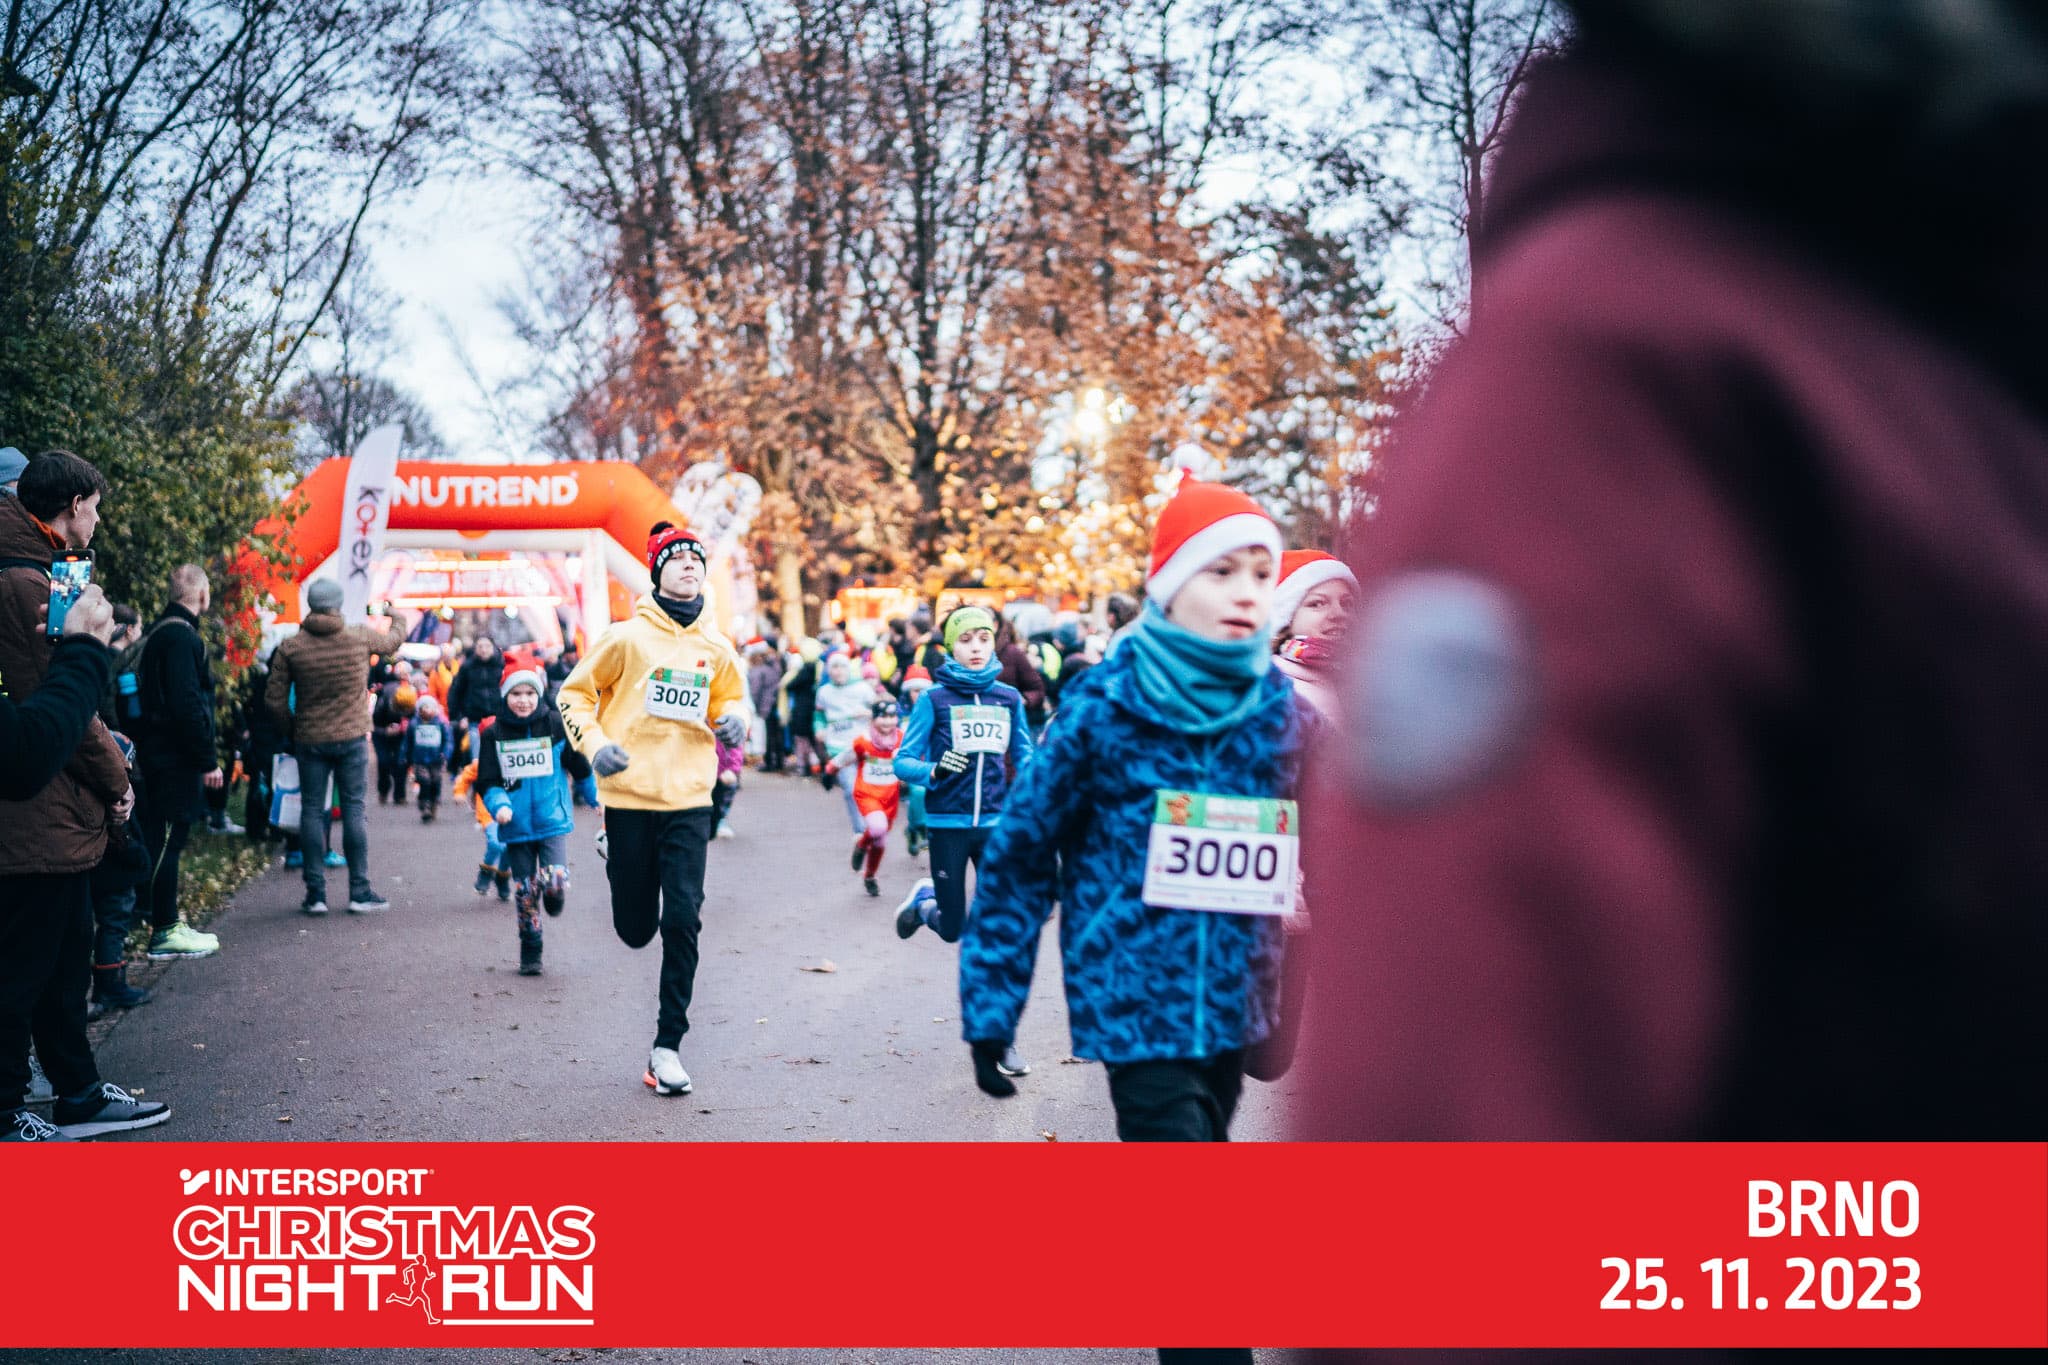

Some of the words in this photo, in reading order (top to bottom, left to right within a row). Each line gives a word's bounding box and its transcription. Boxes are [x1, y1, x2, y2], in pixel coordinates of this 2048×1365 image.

[391, 475, 580, 507] NUTREND
[653, 685, 701, 707] 3002
[961, 723, 1002, 739] 3072
[507, 752, 546, 768] 3040
[1165, 836, 1278, 881] 3000
